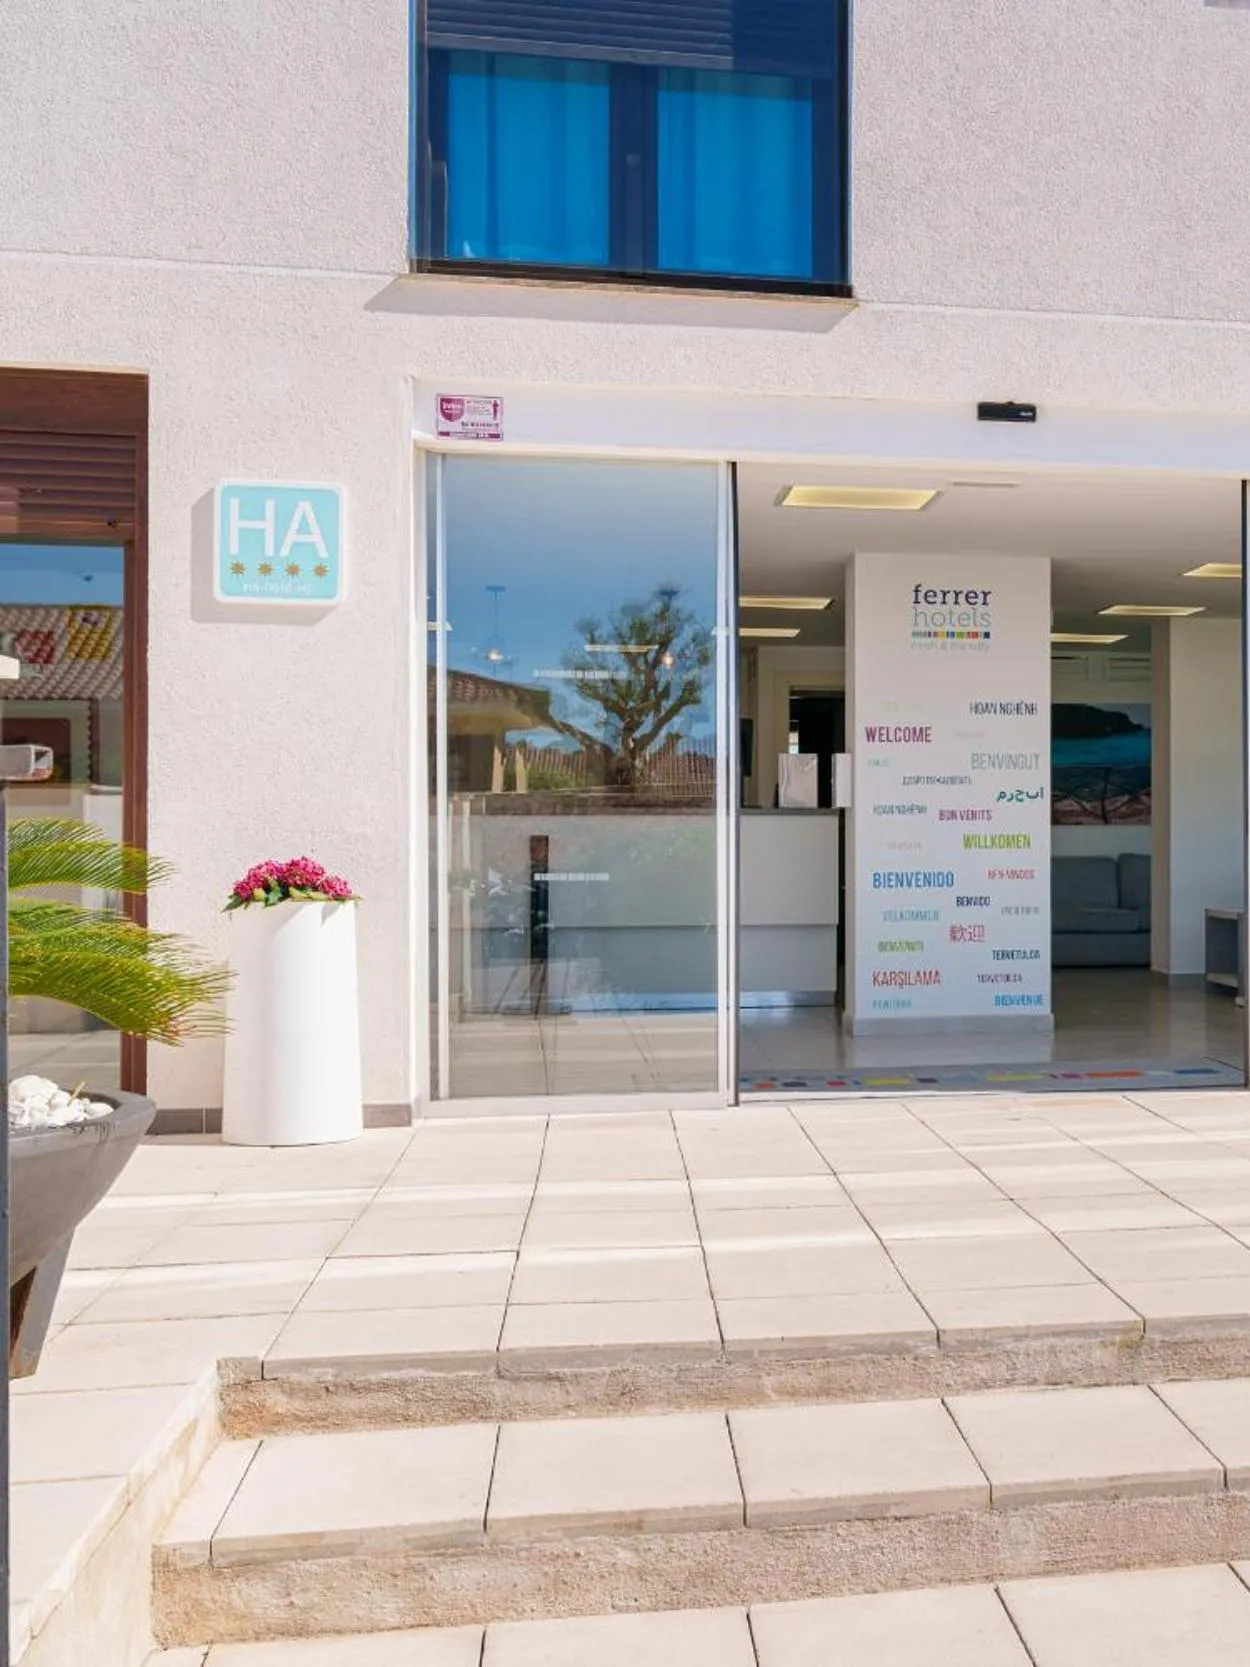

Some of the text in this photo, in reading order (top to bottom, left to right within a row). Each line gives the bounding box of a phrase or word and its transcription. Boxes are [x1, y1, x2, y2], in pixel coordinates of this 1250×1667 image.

[229, 497, 329, 559] HA
[912, 584, 992, 606] ferrer
[912, 607, 992, 628] hotels
[969, 702, 997, 716] HOAN
[865, 726, 932, 743] WELCOME
[970, 752, 1041, 770] BENVINGUT
[872, 871, 954, 888] BIENVENIDO
